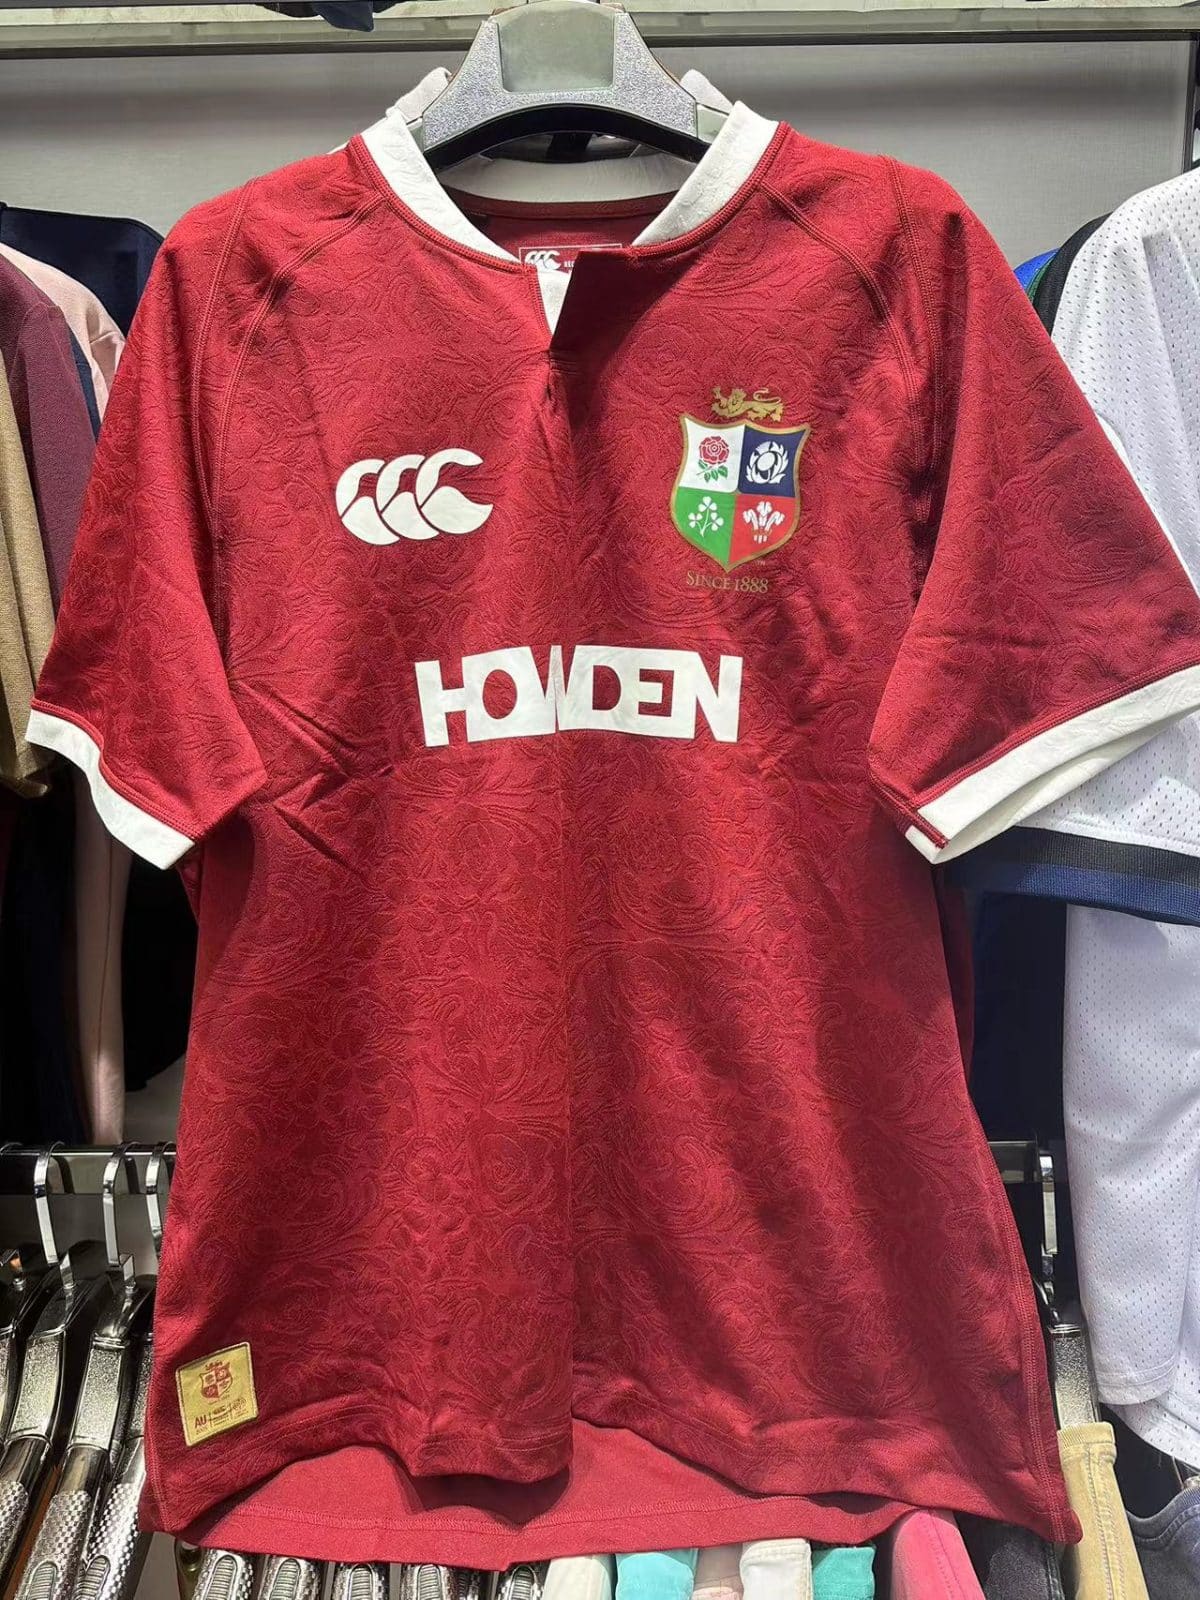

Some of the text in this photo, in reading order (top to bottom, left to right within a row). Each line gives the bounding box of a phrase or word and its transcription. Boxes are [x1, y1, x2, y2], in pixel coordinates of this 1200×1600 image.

[687, 570, 769, 594] SINCE 1888
[414, 645, 744, 747] HOWDEN
